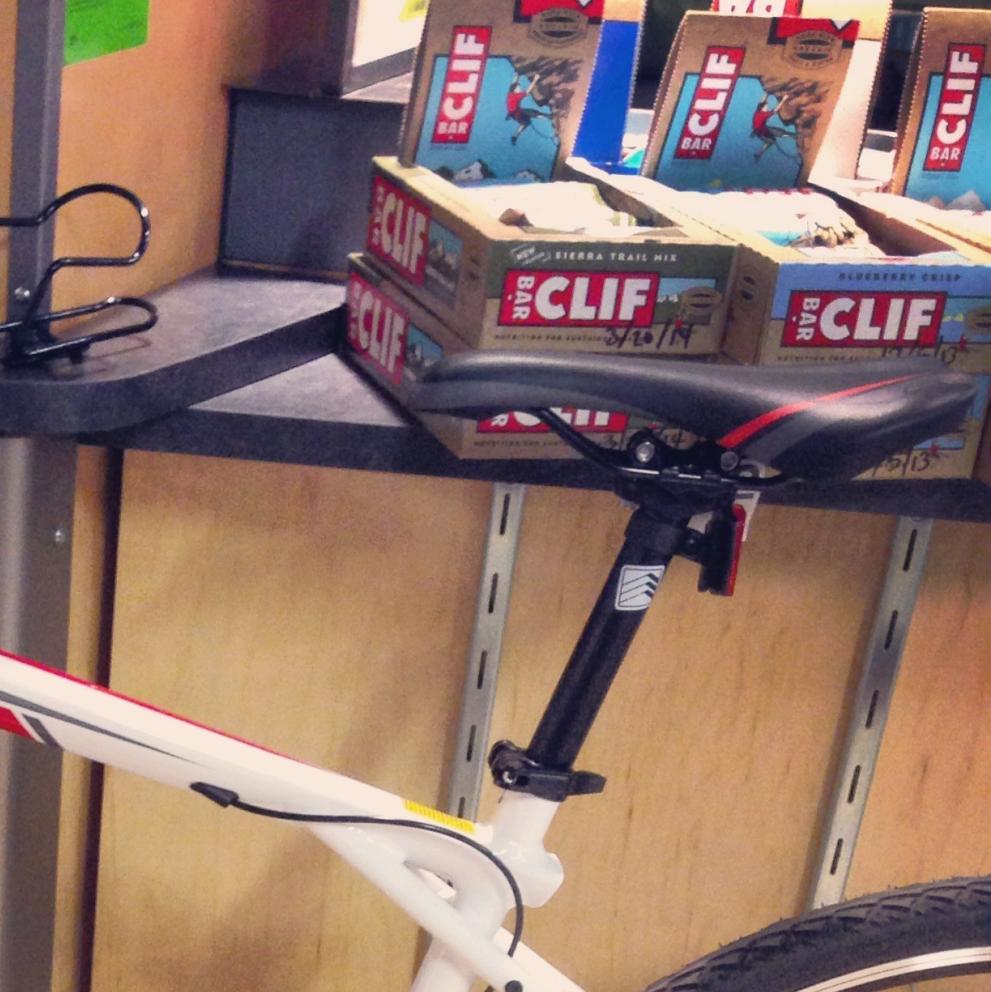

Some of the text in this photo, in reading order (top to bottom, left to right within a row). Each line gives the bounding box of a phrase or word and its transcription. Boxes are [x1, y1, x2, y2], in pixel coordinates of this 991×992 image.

[442, 32, 486, 120] CLIF
[688, 53, 737, 136] CLIF
[936, 51, 979, 144] CLIF
[437, 121, 469, 135] BAR
[680, 137, 712, 150] BAR
[930, 147, 961, 161] BAR
[381, 191, 427, 275] CLIF
[555, 251, 604, 261] SIERRA
[610, 252, 648, 262] TRAIL
[654, 253, 678, 263] MIX
[512, 275, 535, 320] BAR
[535, 275, 651, 321] CLIF
[796, 297, 820, 341] BAR
[819, 297, 937, 341] CLIF
[358, 290, 405, 375] CLIF
